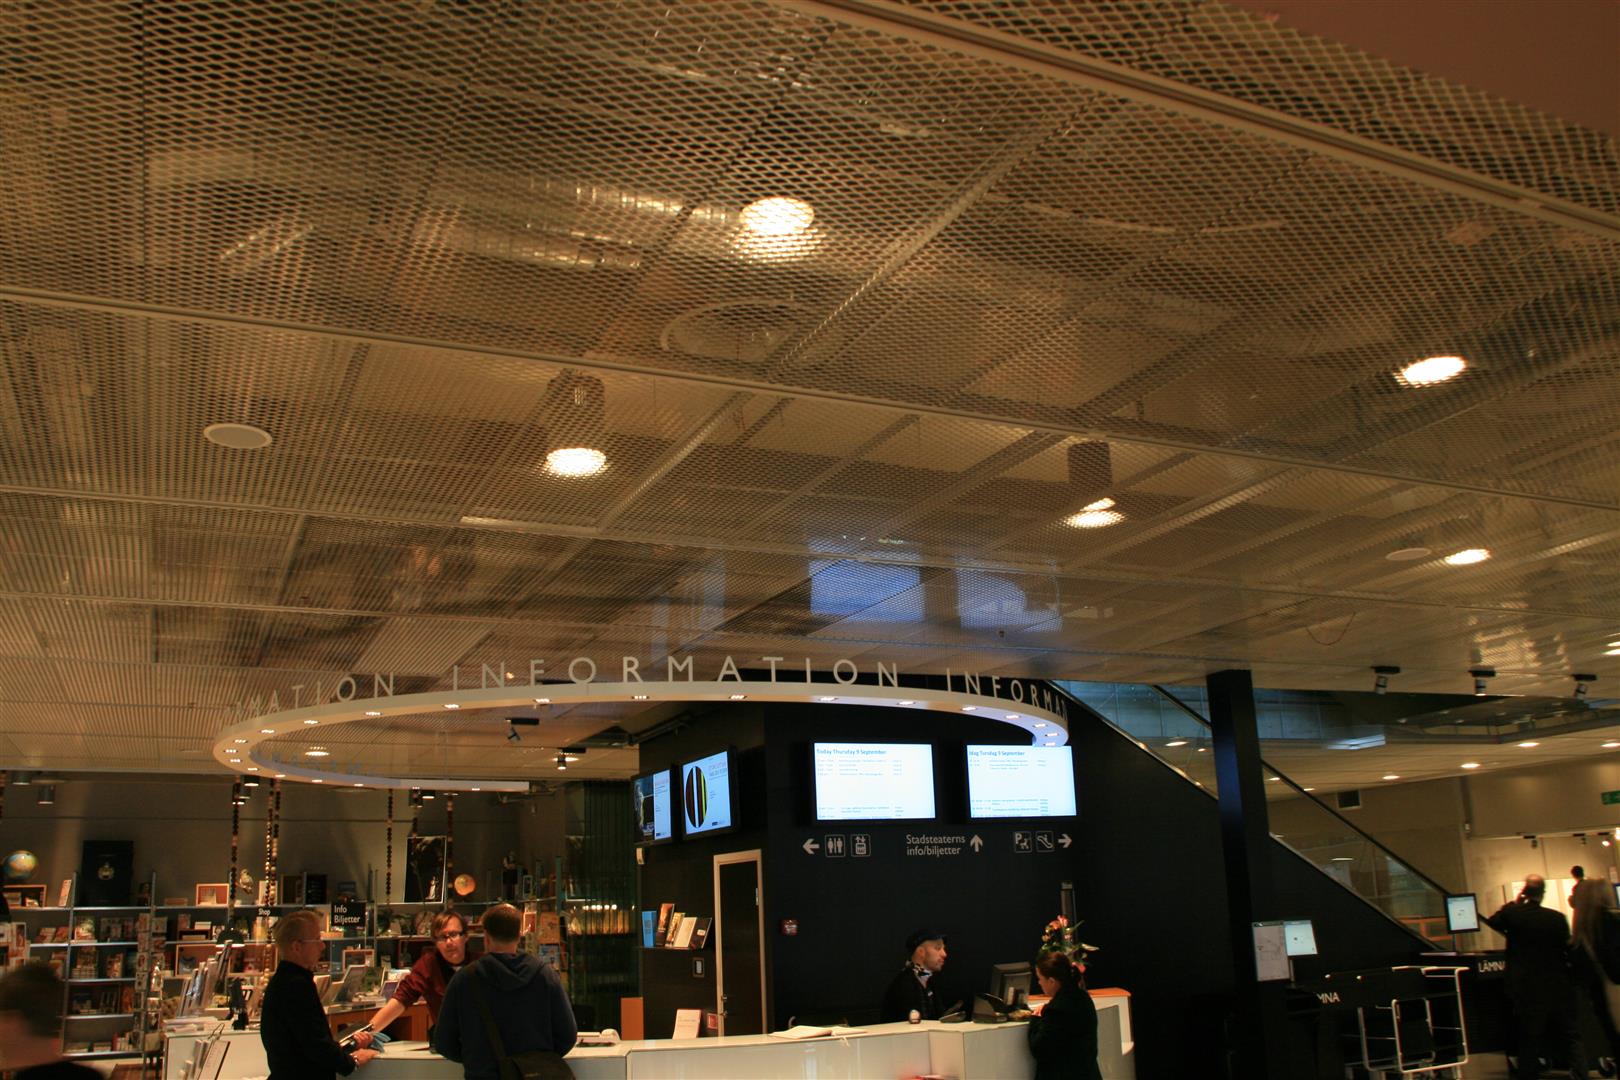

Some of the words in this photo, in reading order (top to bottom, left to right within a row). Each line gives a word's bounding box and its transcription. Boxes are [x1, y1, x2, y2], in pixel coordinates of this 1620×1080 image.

[453, 655, 899, 691] INFORMATION
[833, 748, 855, 756] Thursday
[906, 834, 966, 844] Stadsteaterns
[906, 846, 961, 857] info/biljetter
[258, 908, 271, 917] Shop
[334, 904, 347, 914] Info
[334, 914, 361, 925] Biljetter
[1478, 960, 1506, 973] LÄMN
[1316, 991, 1341, 1004] MNA
